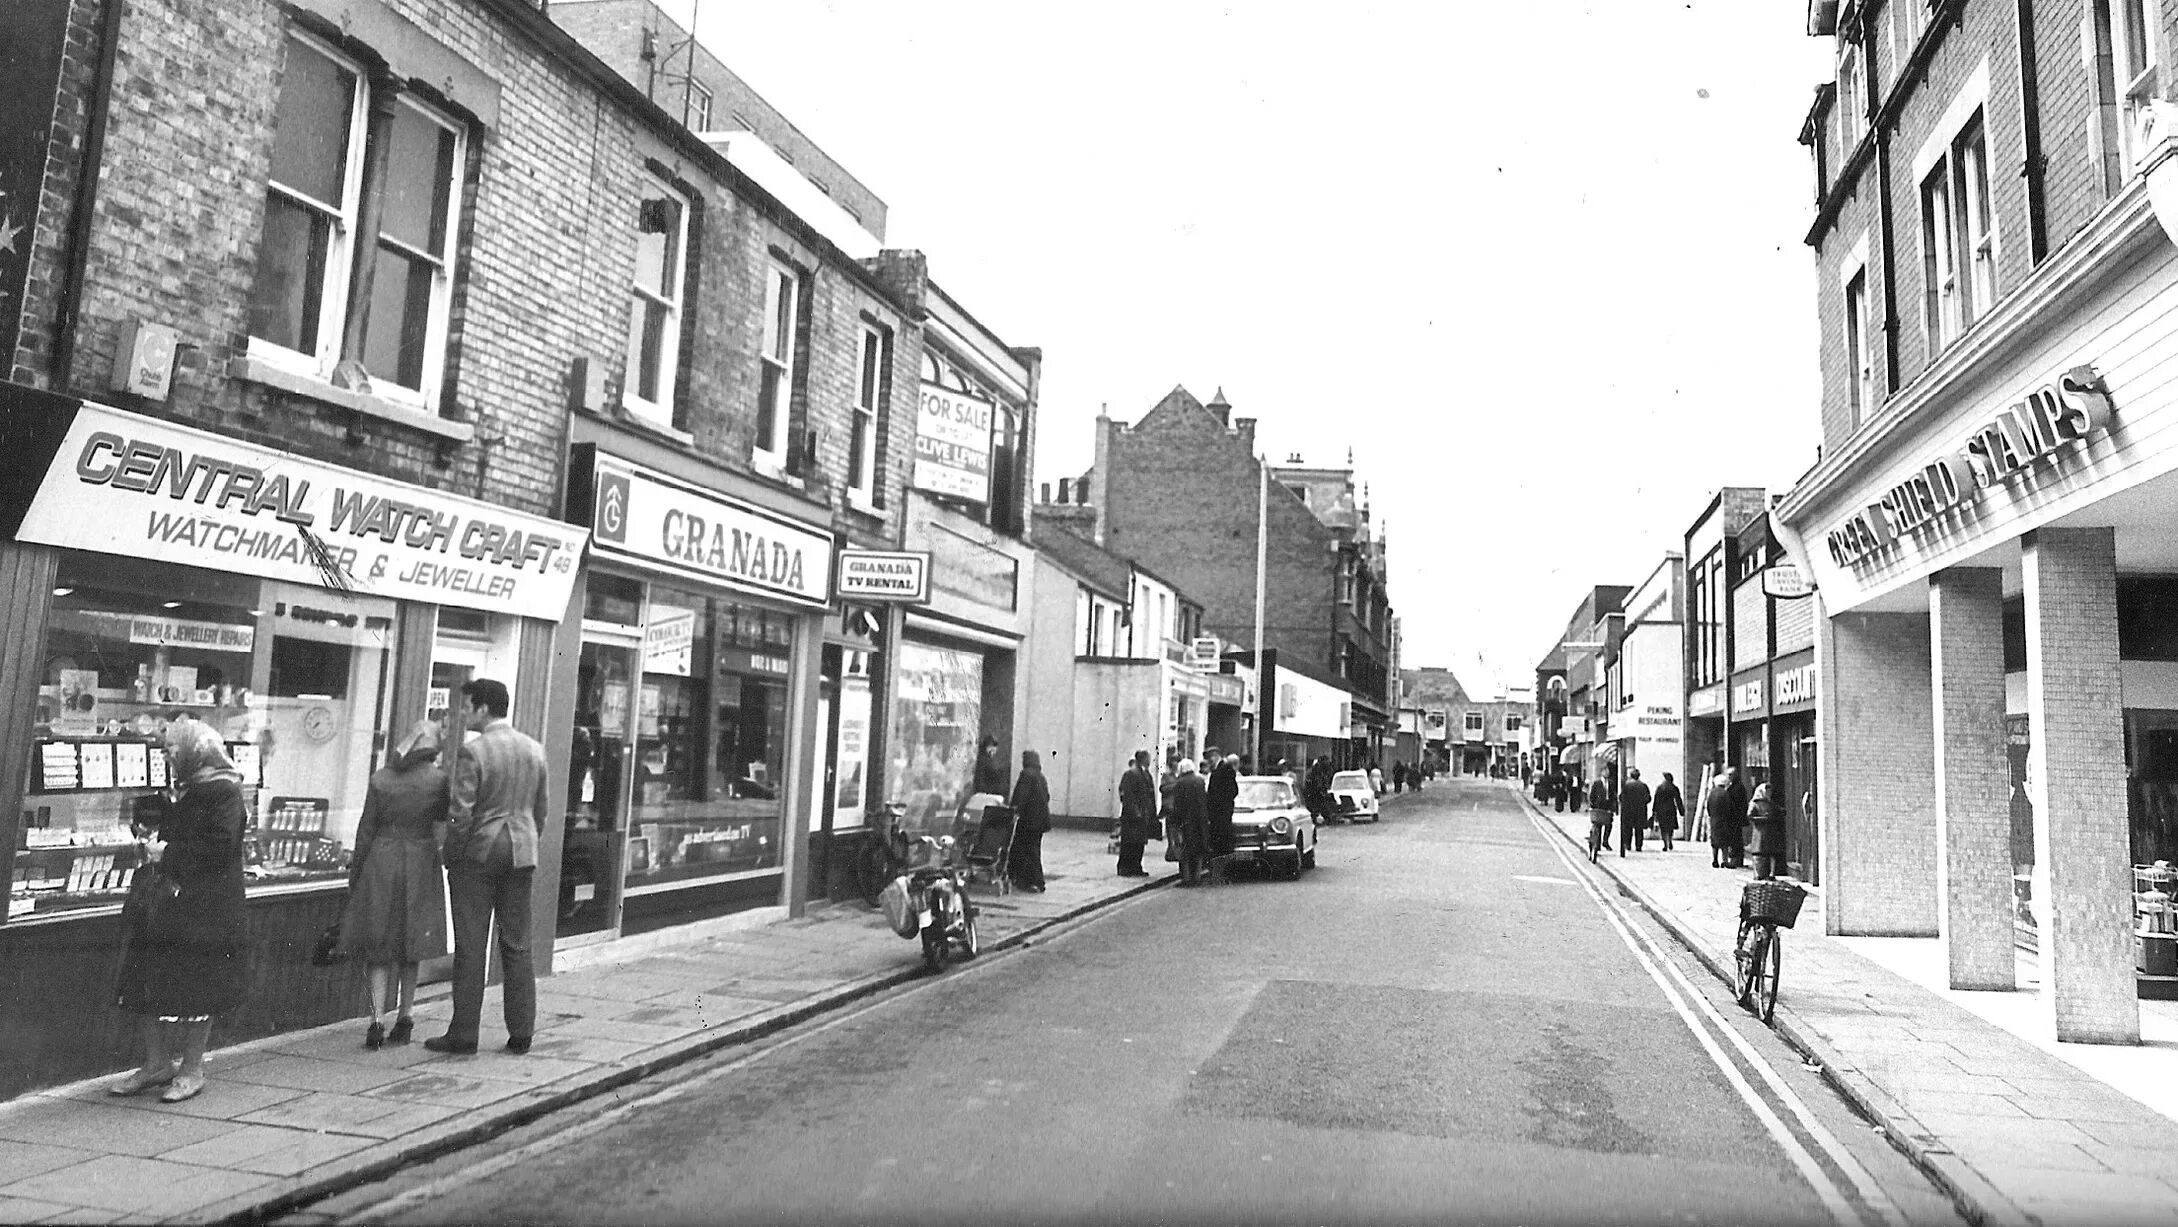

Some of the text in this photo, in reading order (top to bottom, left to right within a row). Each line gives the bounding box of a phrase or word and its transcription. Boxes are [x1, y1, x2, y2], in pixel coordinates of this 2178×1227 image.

[920, 391, 988, 432] FOR SALE
[915, 435, 951, 460] CLIVE
[953, 445, 988, 470] LEWIS
[1827, 370, 2098, 568] GREEN SHIELD STAMPS
[76, 431, 315, 527] CENTRAL
[330, 487, 459, 553] WATCH
[459, 519, 562, 574] CRAFT
[662, 508, 805, 591] GRANADA
[369, 554, 389, 578] &
[399, 561, 516, 600] JEWELLER
[847, 576, 914, 590] TV RENTAL
[849, 561, 913, 575] GRANADA
[133, 619, 252, 647] WATCH & JEWELLERY REPAIRS
[430, 691, 446, 706] PEN
[1647, 705, 1673, 715] PEKING
[1638, 716, 1682, 726] RESTAURANT
